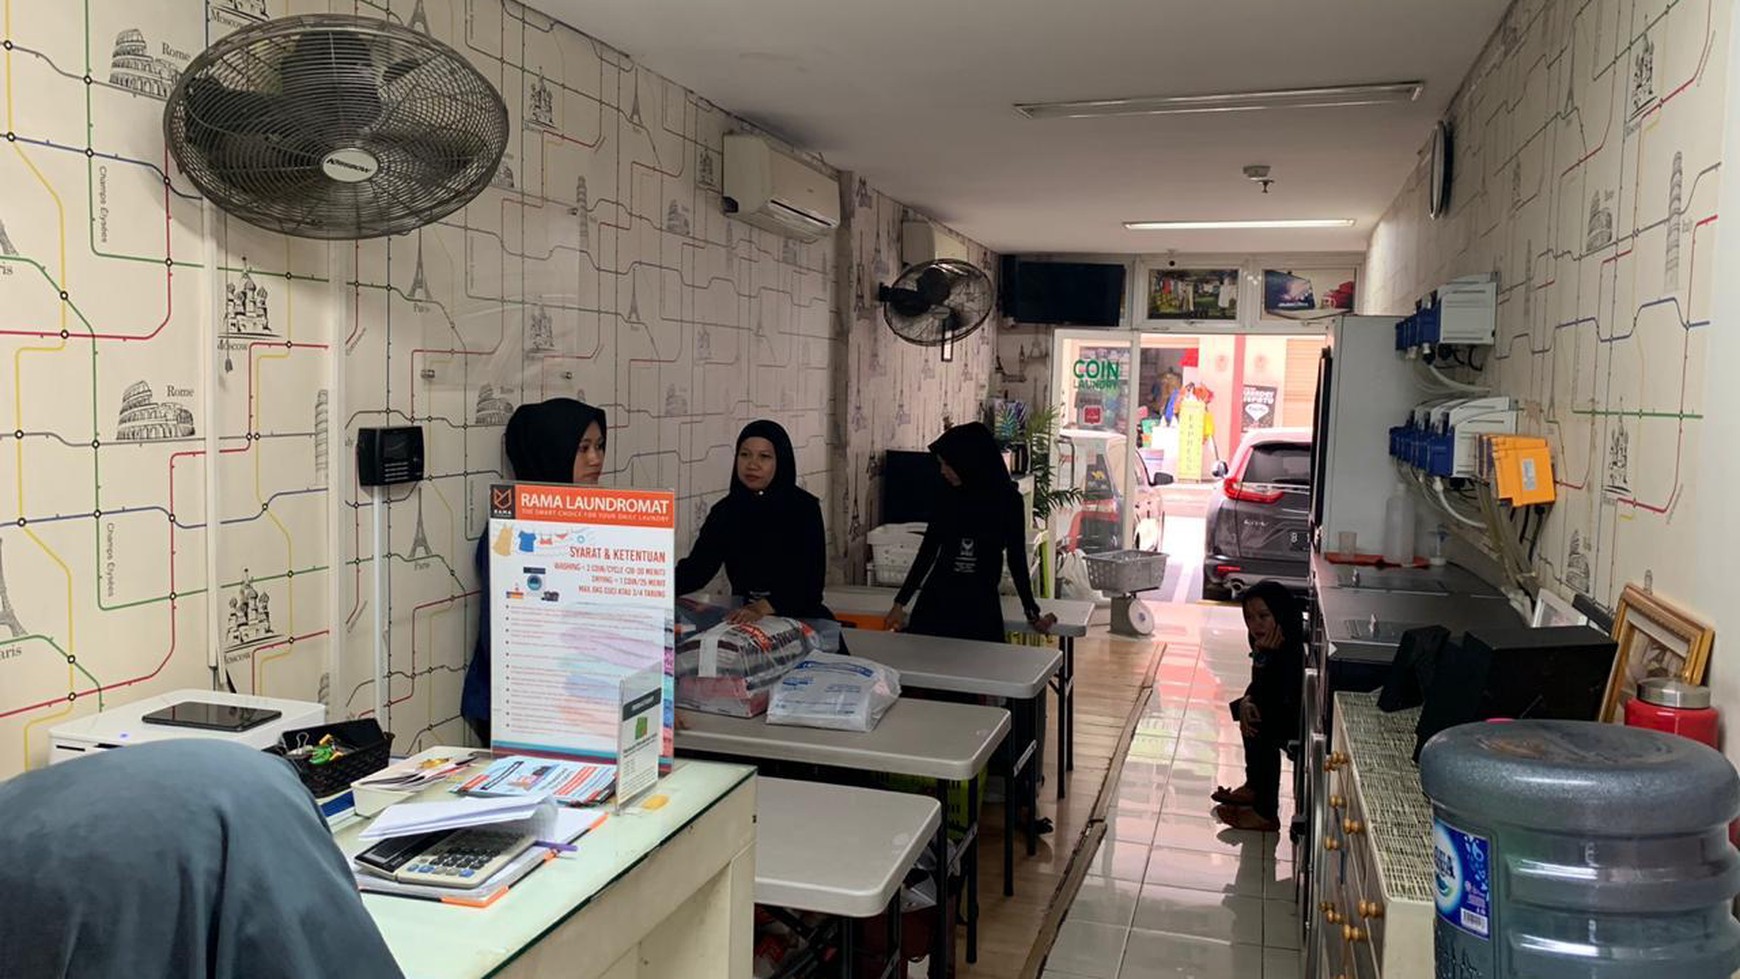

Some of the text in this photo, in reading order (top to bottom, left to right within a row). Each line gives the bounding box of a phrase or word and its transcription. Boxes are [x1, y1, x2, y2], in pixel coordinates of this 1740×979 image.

[162, 42, 191, 61] Rome
[1073, 359, 1119, 379] COIN
[167, 386, 194, 397] Rome
[1073, 379, 1117, 390] LAUNDRY
[521, 493, 669, 514] RAMA LAUNDROMAT
[569, 546, 666, 563] SYARAT & KETENTUAN
